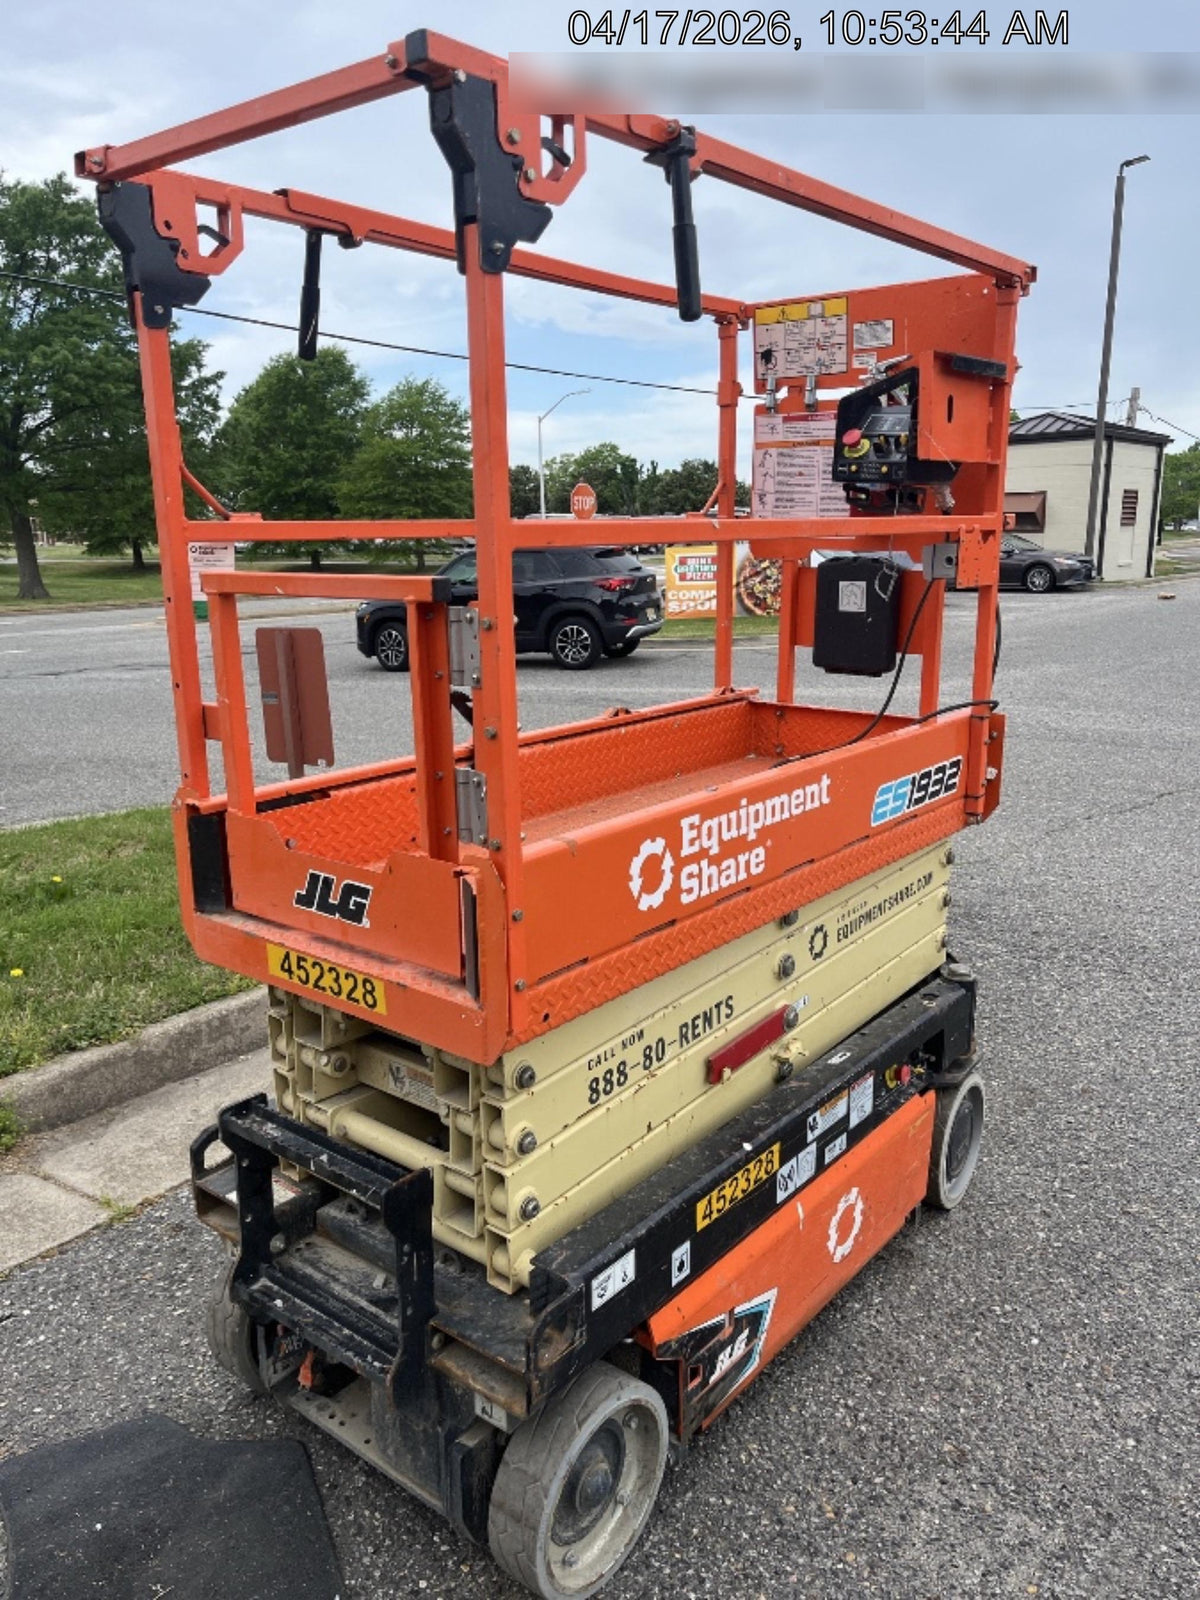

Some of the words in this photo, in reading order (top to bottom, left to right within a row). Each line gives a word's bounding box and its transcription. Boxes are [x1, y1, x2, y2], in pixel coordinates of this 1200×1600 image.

[573, 495, 595, 511] STOP
[680, 773, 831, 858] Equipment
[871, 756, 962, 826] ES1932
[293, 868, 374, 928] JLG
[680, 845, 766, 905] Share
[279, 950, 379, 1009] 452328
[587, 1046, 617, 1071] CALL
[621, 1029, 645, 1051] NOW
[588, 994, 735, 1104] 888-80-RENTS
[702, 1149, 776, 1223] 452328
